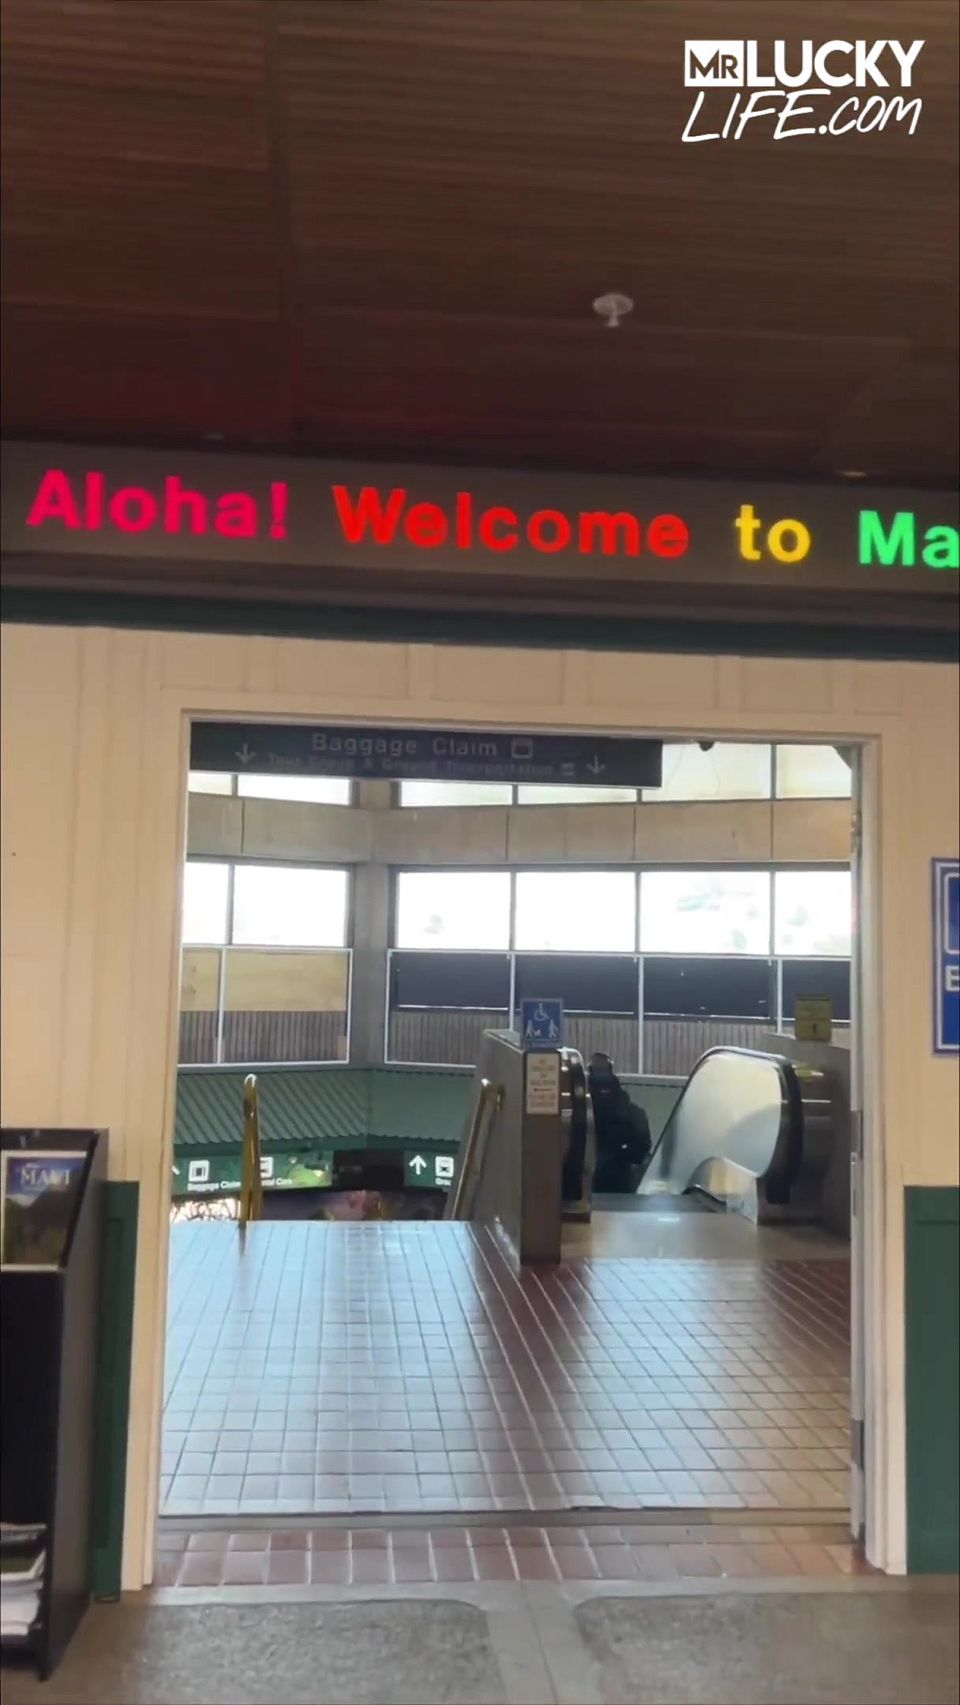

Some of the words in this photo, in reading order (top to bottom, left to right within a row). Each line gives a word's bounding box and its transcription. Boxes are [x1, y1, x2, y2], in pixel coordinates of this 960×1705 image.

[26, 469, 289, 540] Aloha!
[331, 485, 690, 558] Welcome
[735, 504, 811, 563] to
[311, 732, 417, 757] Baggage
[432, 737, 497, 756] Claim
